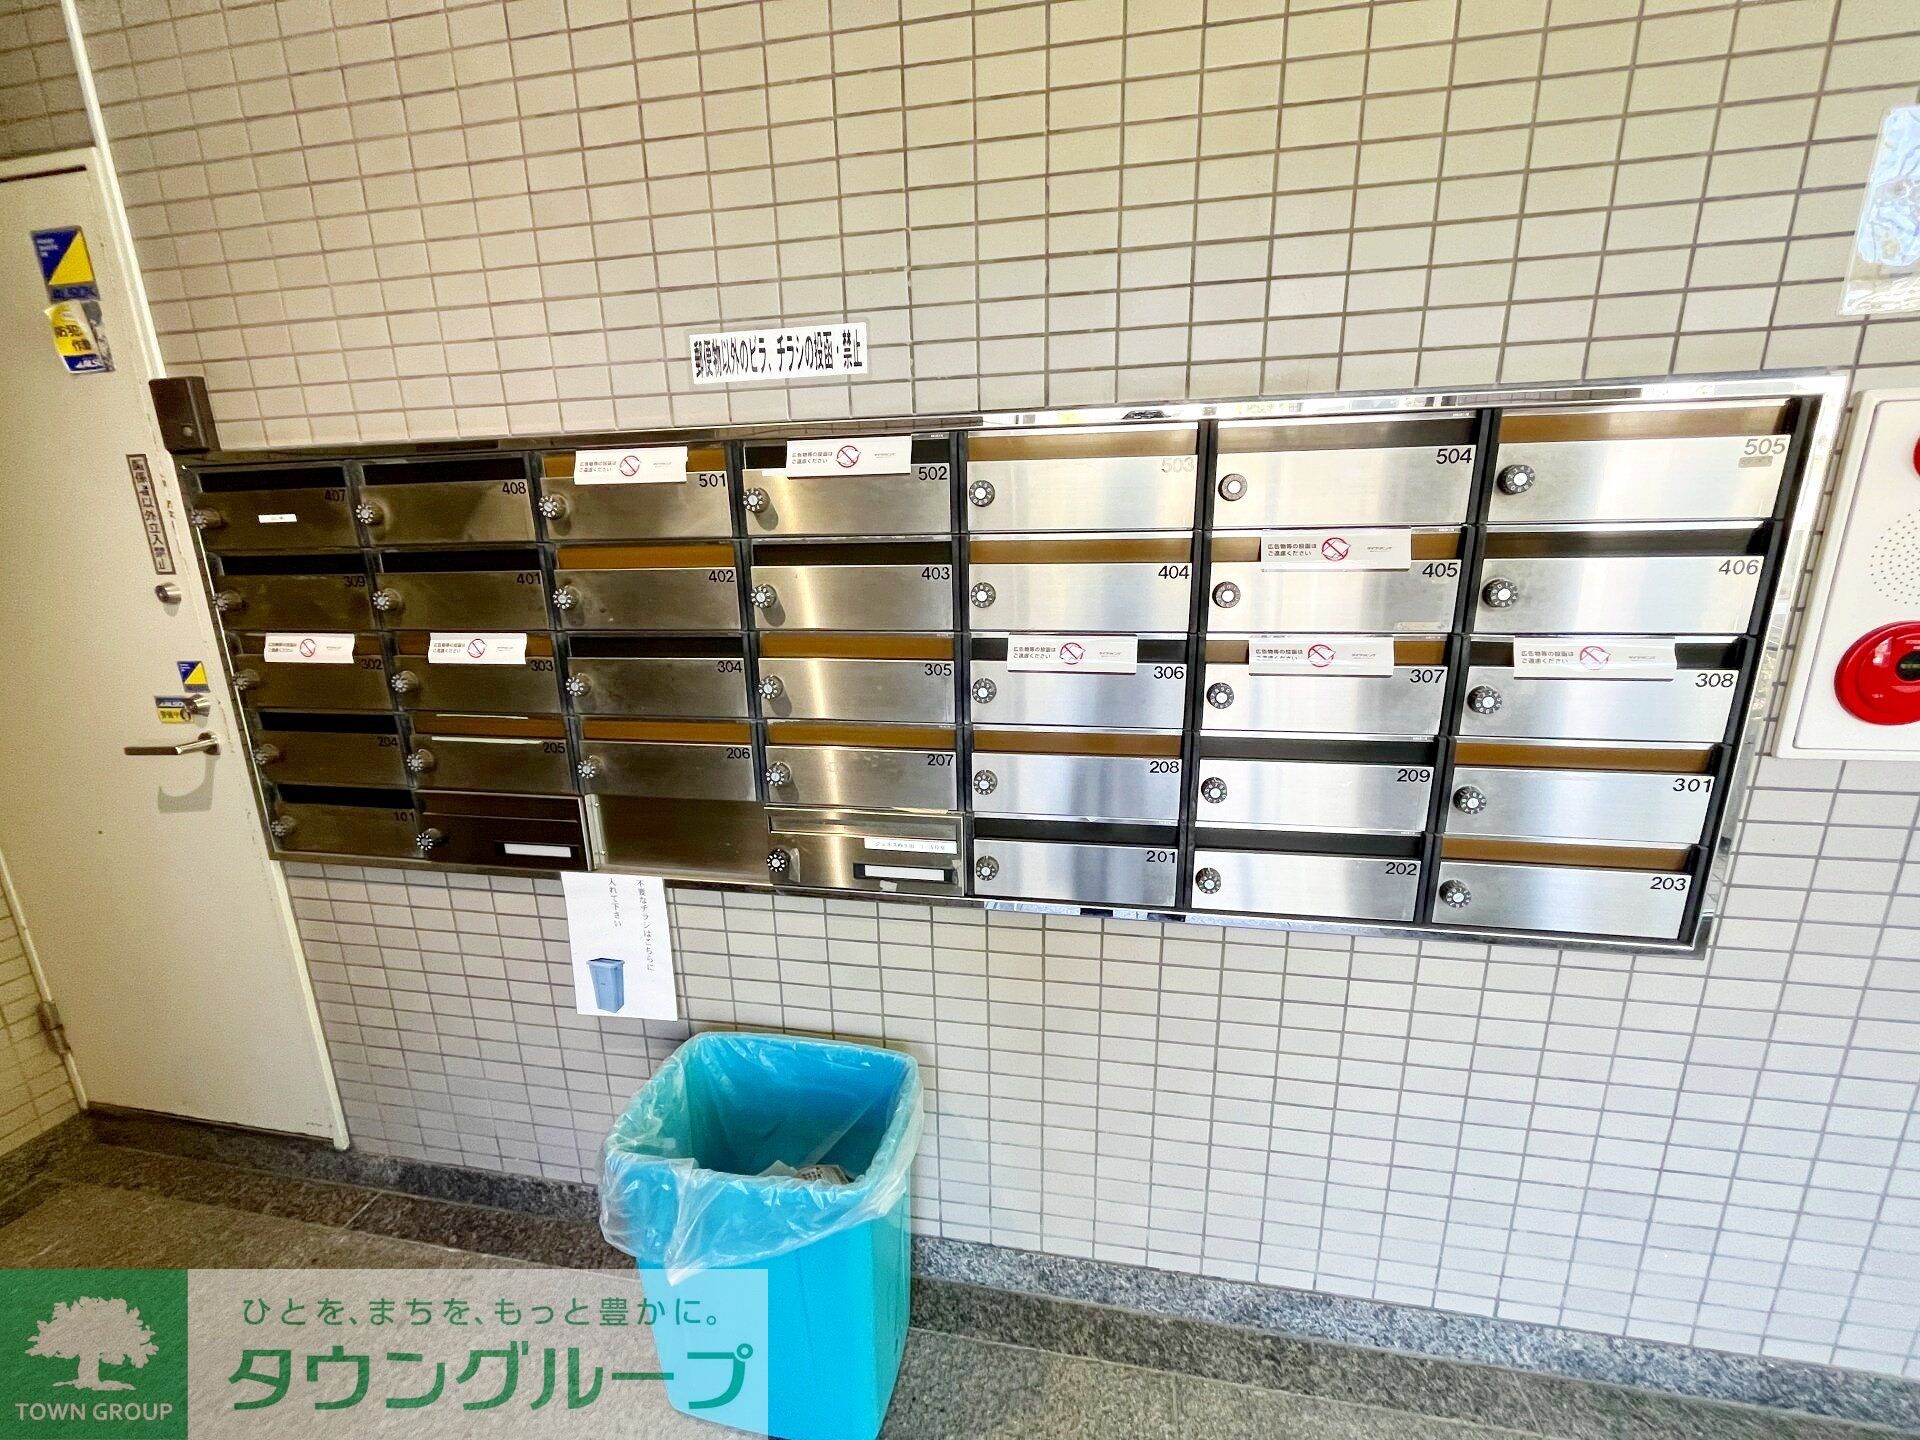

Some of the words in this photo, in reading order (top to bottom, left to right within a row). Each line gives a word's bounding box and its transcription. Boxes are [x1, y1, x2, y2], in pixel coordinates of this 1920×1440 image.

[1744, 438, 1785, 455] 505
[1436, 448, 1472, 465] 504
[1162, 458, 1194, 474] 503
[918, 466, 947, 480] 502
[699, 474, 726, 487] 501
[325, 489, 346, 501] 407
[502, 482, 526, 495] 408
[922, 567, 949, 581] 403
[1158, 566, 1189, 580] 404
[1422, 562, 1457, 578] 405
[1718, 560, 1759, 576] 406
[517, 573, 541, 585] 401
[708, 570, 734, 583] 402
[361, 659, 382, 670] 302
[531, 660, 553, 672] 303
[718, 660, 742, 673] 304
[924, 663, 952, 676] 305
[1154, 666, 1184, 680] 306
[1410, 669, 1444, 684] 307
[1695, 673, 1733, 688] 308
[543, 742, 565, 753] 205
[726, 748, 750, 759] 206
[927, 754, 953, 767] 207
[1149, 760, 1180, 774] 208
[1397, 769, 1430, 782] 209
[1673, 779, 1712, 793] 301
[394, 812, 414, 822] 101
[1146, 851, 1176, 863] 201
[1385, 863, 1417, 876] 202
[1650, 877, 1686, 891] 203
[608, 878, 622, 928] 入れて下さい
